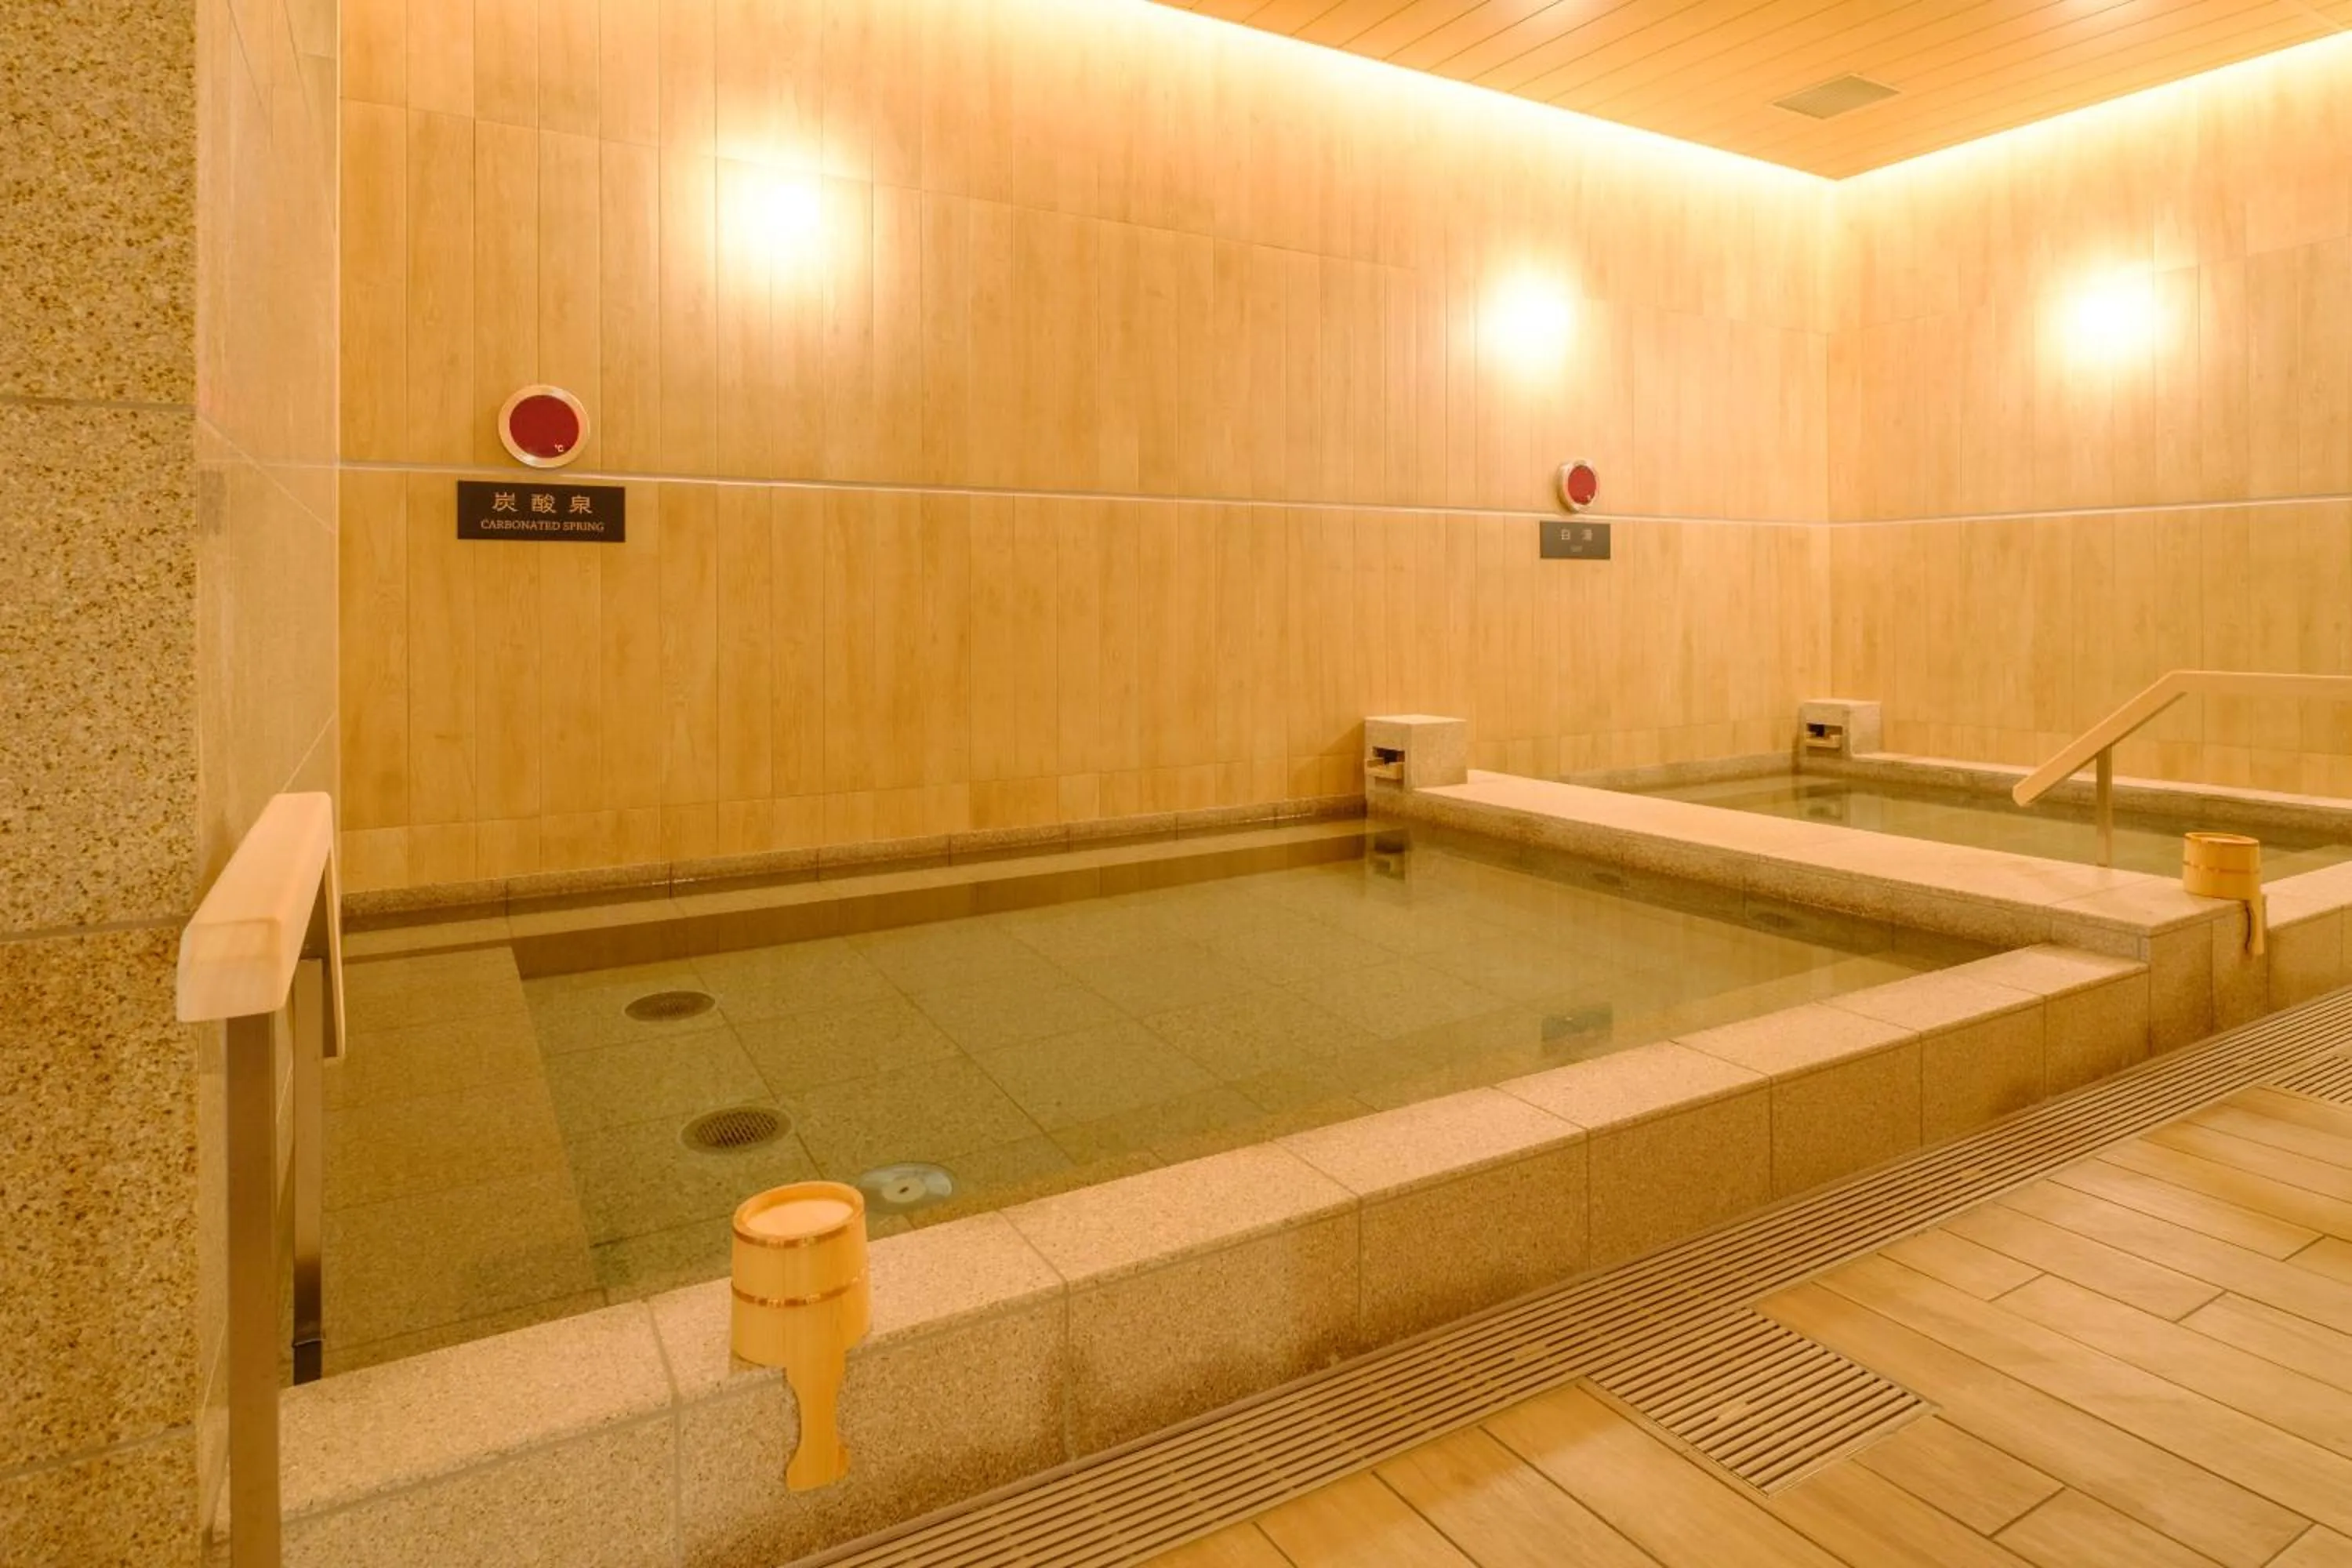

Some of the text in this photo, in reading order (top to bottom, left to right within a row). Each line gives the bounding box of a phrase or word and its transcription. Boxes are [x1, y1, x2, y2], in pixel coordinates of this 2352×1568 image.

[492, 492, 593, 514] 炭酸泉
[481, 519, 604, 532] CARBONATED SPRING
